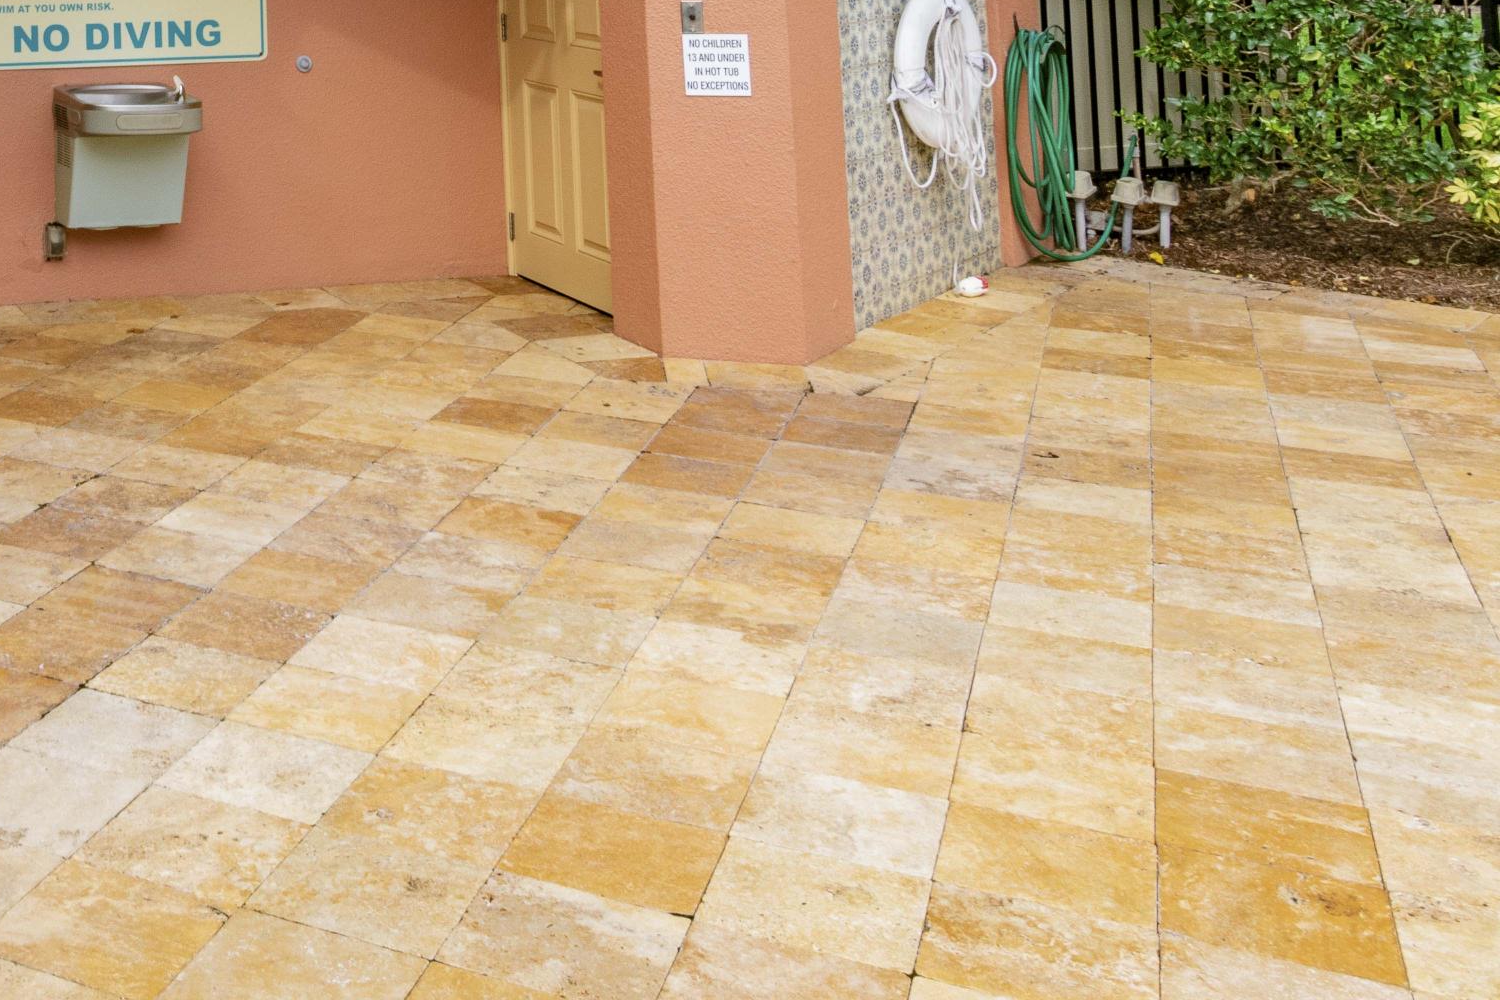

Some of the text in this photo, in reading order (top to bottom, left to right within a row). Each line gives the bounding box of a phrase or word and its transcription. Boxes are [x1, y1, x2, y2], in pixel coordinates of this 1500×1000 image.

[18, 5, 31, 13] AT
[34, 5, 56, 13] YOU
[59, 4, 83, 12] OWN
[87, 3, 113, 11] RISK.
[14, 19, 220, 53] NO DIVING
[689, 39, 742, 48] NO CHILDREN
[688, 53, 745, 62] 13 AND UNDER
[695, 67, 739, 76] IN HOT TUB
[687, 81, 749, 91] NO EXCEPTIONS
